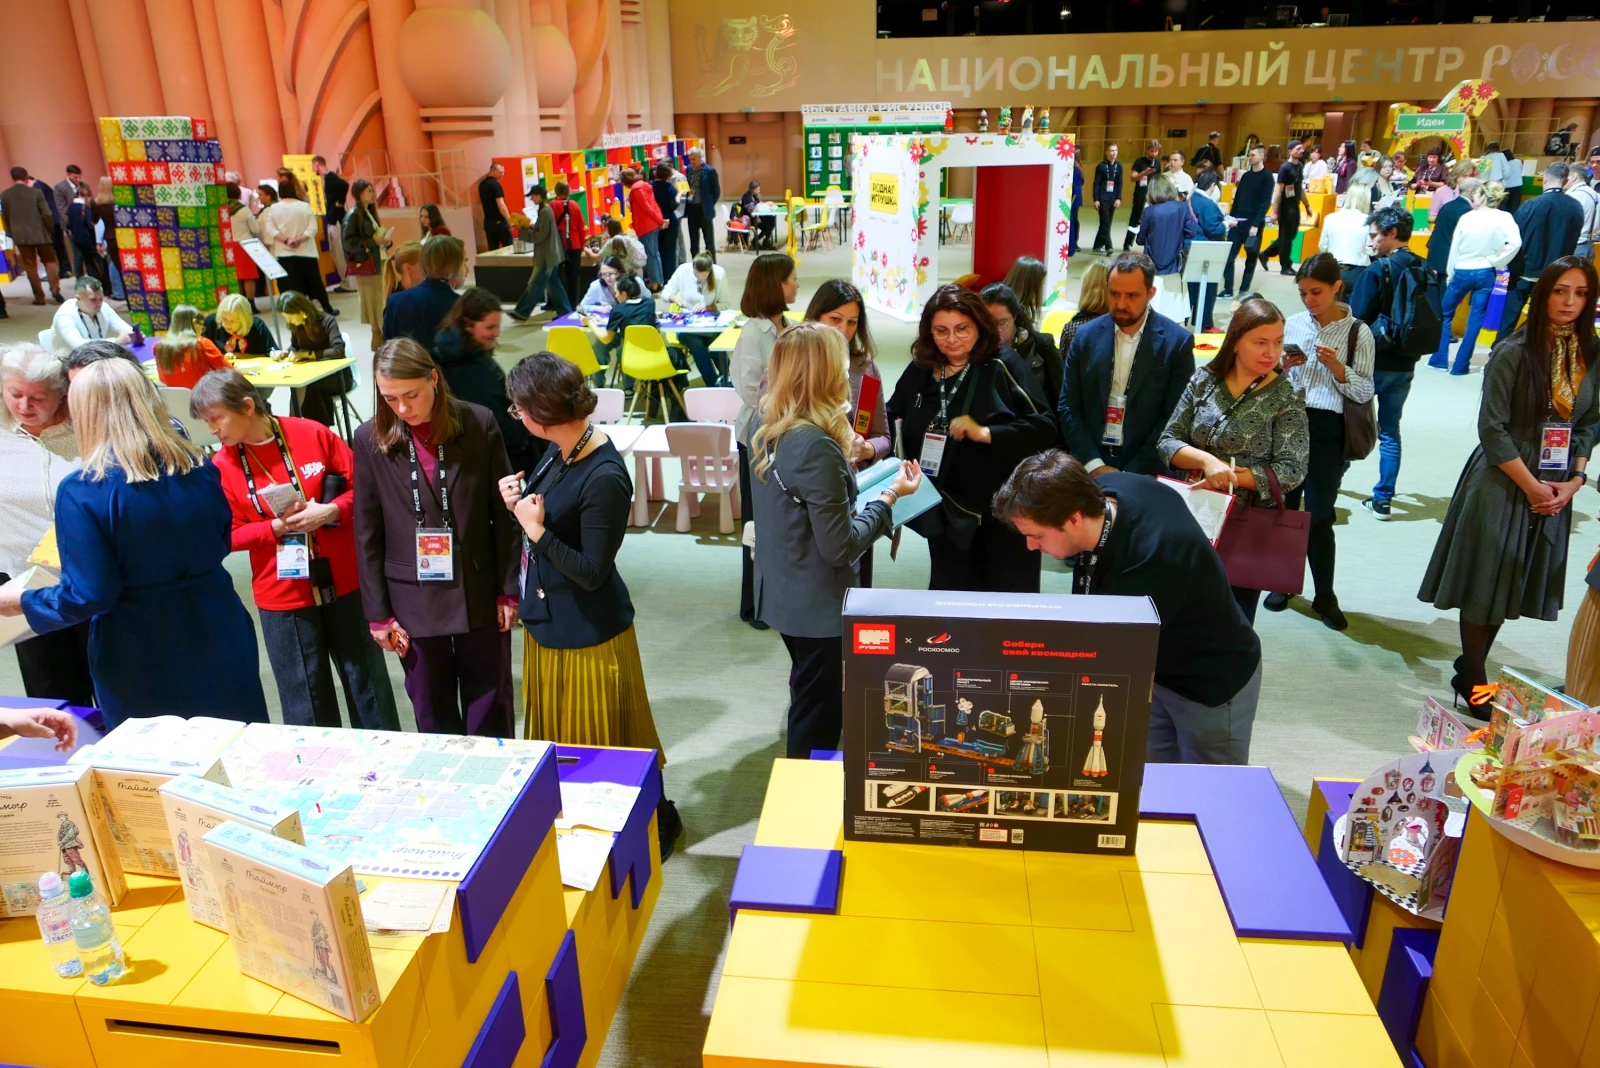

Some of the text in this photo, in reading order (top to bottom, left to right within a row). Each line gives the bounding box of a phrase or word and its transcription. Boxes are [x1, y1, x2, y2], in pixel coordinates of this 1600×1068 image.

[877, 41, 1289, 97] НАЦИОНАЛЬНЫЙ
[1304, 46, 1464, 92] ЦЕНТР
[802, 102, 952, 114] ВЫСТАВКА РИСУНКОВ
[1416, 117, 1445, 127] Идеи
[1002, 640, 1045, 649] Собери
[1030, 650, 1097, 658] космодром!
